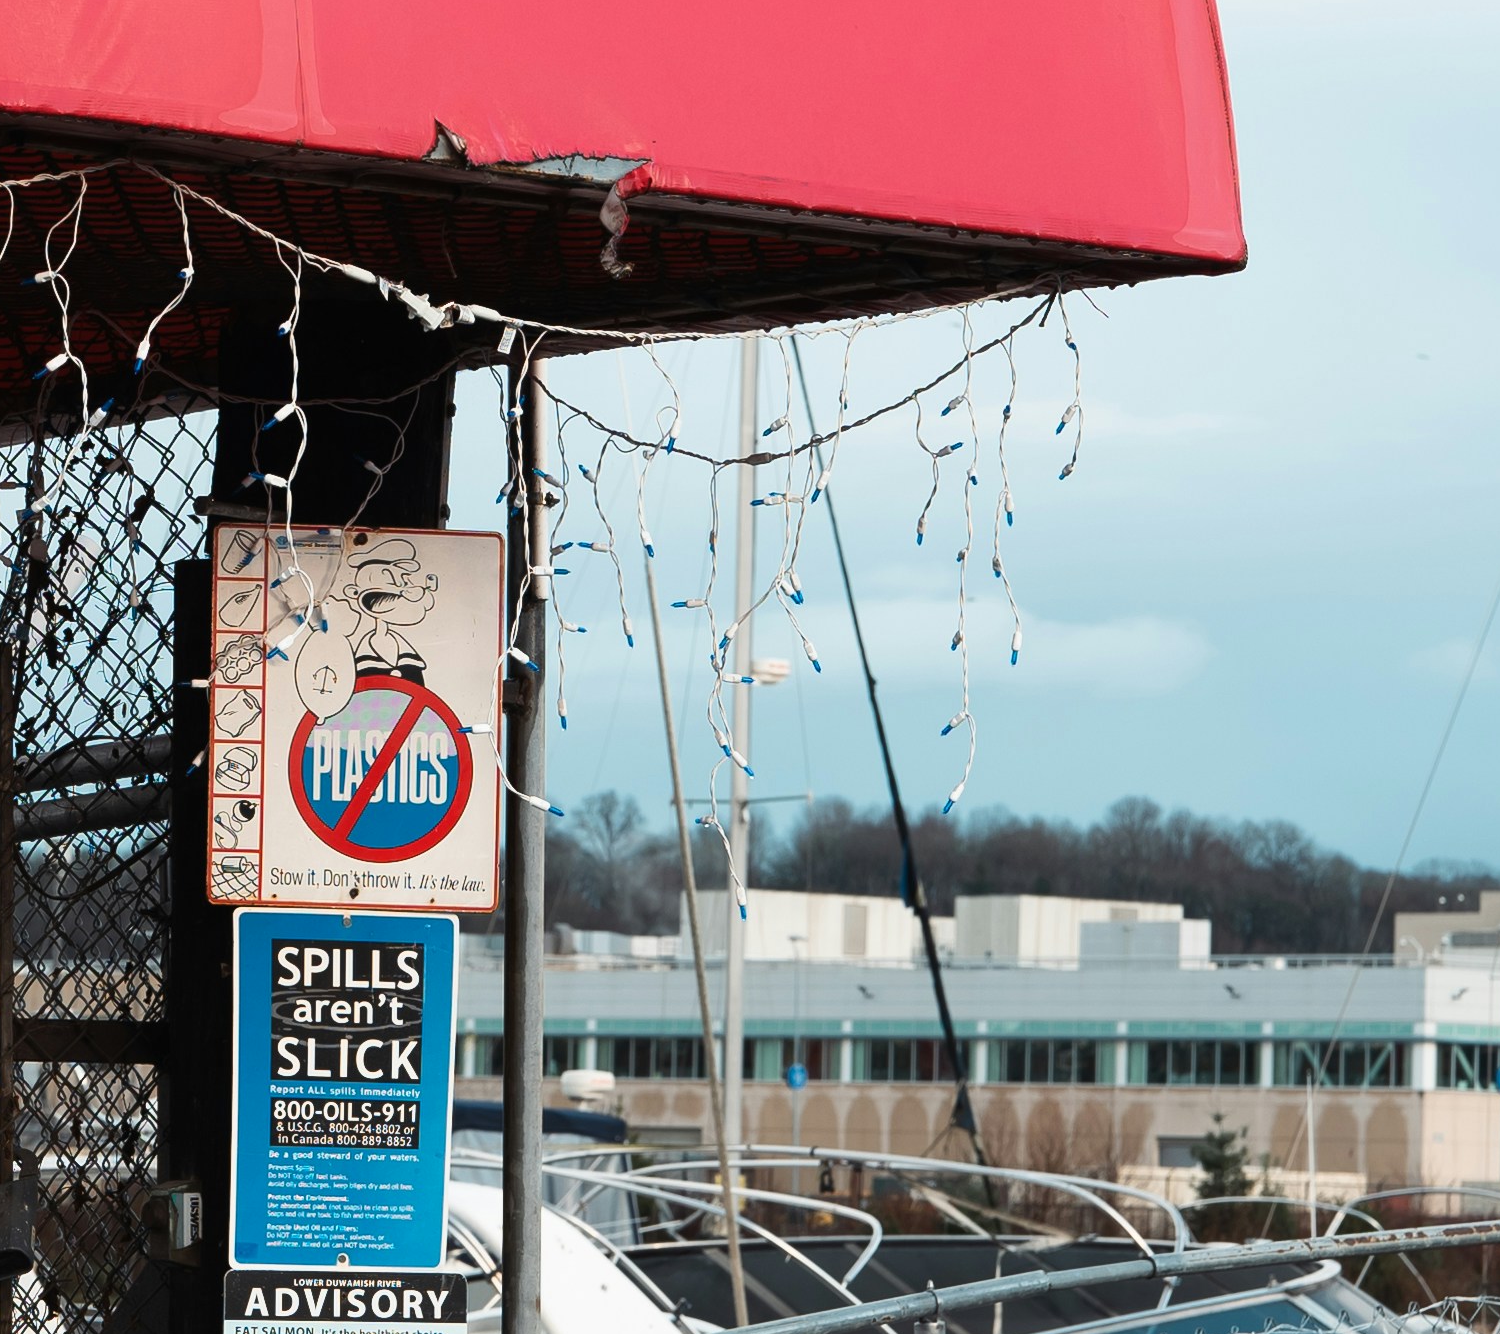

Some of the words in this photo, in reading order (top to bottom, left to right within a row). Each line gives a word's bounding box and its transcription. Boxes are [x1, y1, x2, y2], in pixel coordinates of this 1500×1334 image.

[270, 868, 303, 885] Stow
[307, 868, 319, 888] it,
[362, 872, 400, 889] throw
[404, 872, 415, 889] it.
[420, 874, 437, 890] It's
[440, 875, 459, 891] the
[462, 876, 486, 892] law.
[278, 947, 420, 990] SPILLS
[293, 994, 403, 1025] aren't
[277, 1036, 419, 1080] SLICK
[270, 1085, 304, 1095] Report
[308, 1086, 326, 1095] ALL
[330, 1087, 356, 1096] spills
[274, 1100, 417, 1123] 800-OILS-911
[276, 1122, 284, 1132] &
[288, 1122, 324, 1133] U.S.C.G.
[329, 1123, 401, 1135] 800-424-8802
[404, 1127, 415, 1135] or
[278, 1134, 288, 1144] in
[292, 1134, 333, 1145] Canada
[337, 1135, 412, 1147] 800-889-8852
[293, 1279, 323, 1287] LOWER
[326, 1279, 375, 1287] DUWAMISH
[377, 1280, 402, 1288] RIVER
[245, 1287, 450, 1319] ADVISORY
